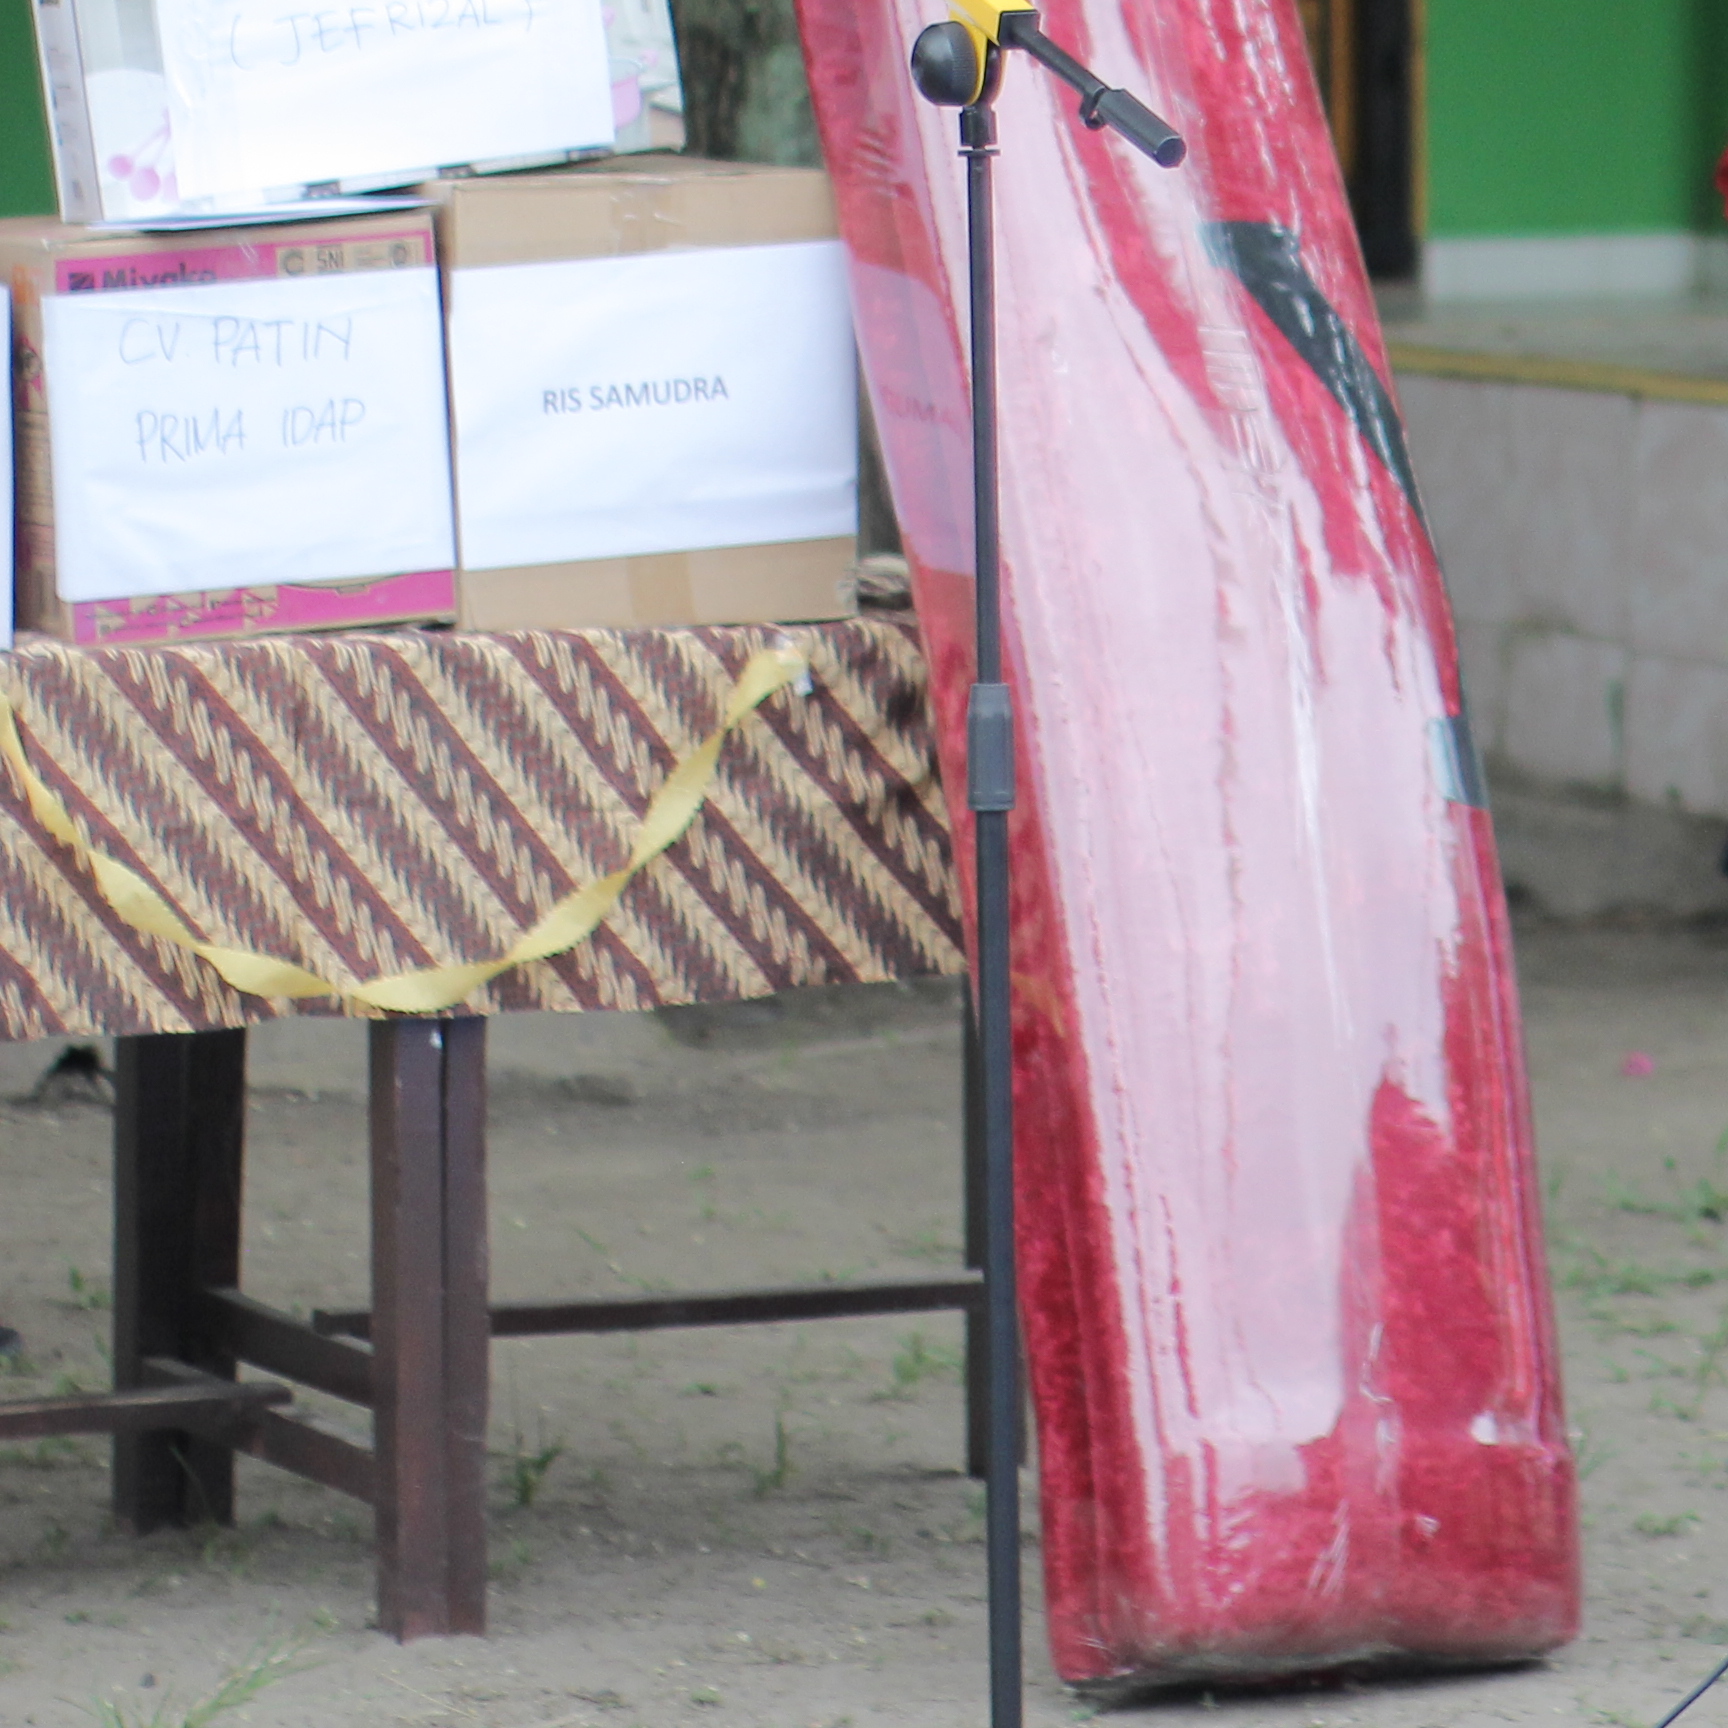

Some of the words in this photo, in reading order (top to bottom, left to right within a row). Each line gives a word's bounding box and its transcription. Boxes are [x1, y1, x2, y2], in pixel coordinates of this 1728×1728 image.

[212, 315, 353, 369] PATIN
[542, 387, 583, 415] RIS
[588, 375, 731, 411] SAMUDRA
[135, 404, 248, 465] PRIMA
[279, 397, 367, 449] IDAP
